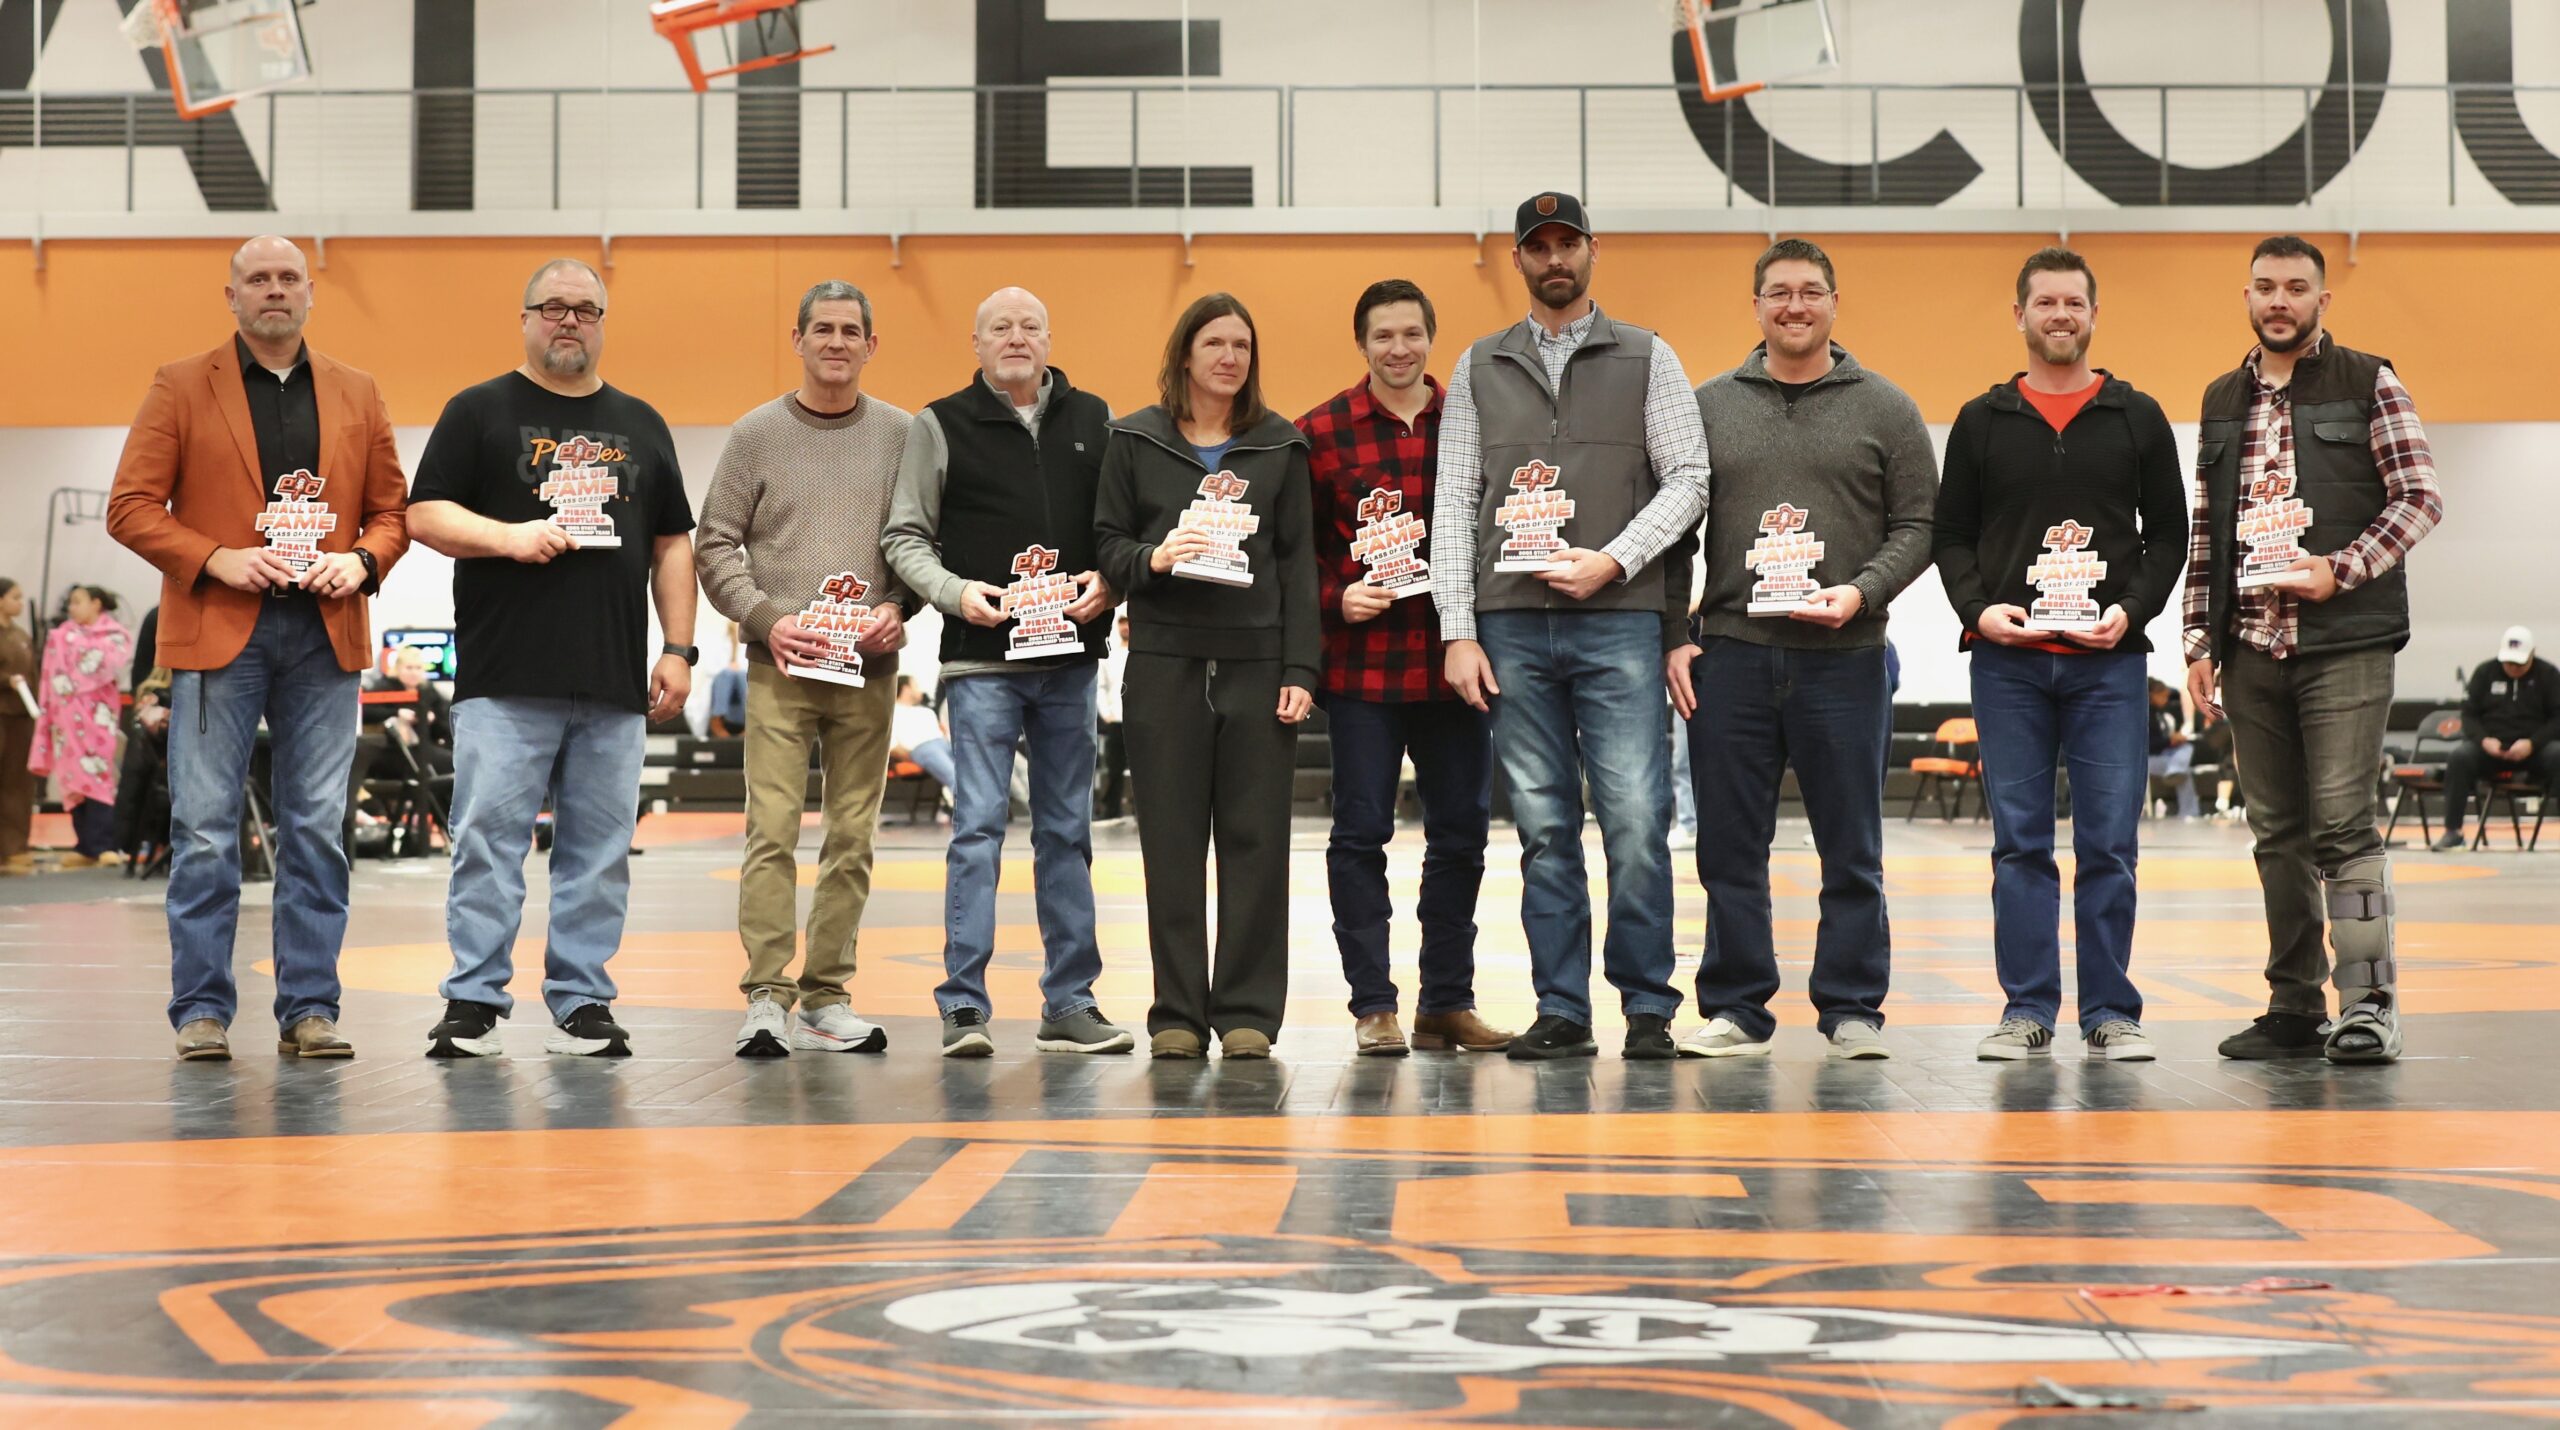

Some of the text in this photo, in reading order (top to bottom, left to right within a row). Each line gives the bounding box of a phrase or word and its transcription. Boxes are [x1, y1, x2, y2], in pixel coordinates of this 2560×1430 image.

[1671, 0, 2560, 208] CO
[553, 468, 607, 481] HALL OF
[544, 479, 617, 498] FAME
[1507, 492, 1562, 506] HALL OF
[270, 504, 326, 513] HALL OF
[1194, 503, 1249, 515] HALL OF
[1498, 501, 1571, 523] FAME
[2247, 501, 2298, 520] HALL OF
[258, 515, 335, 529] FAME
[1183, 512, 1256, 531] FAME
[1359, 515, 1411, 539] HALL OF
[2239, 510, 2308, 539] FAME
[277, 542, 311, 550] PIRATE
[1210, 541, 1233, 550] RATE
[1353, 522, 1424, 560] FAME
[1757, 535, 1812, 549] HALL OF
[2248, 536, 2269, 544] CLASS
[1204, 548, 1241, 559] ESTLING
[1748, 544, 1822, 566] FAME
[2259, 544, 2290, 553] PIRATE
[1365, 550, 1387, 563] CLASS
[2039, 553, 2095, 565] HALL OF
[1378, 558, 1410, 571] PIRATE
[1758, 564, 1781, 572] CLASS
[2029, 562, 2104, 582] FAME
[1011, 576, 1065, 594] HALL OF
[1003, 584, 1076, 612] FAME
[813, 604, 868, 617] HALL OF
[1014, 609, 1036, 617] CLASS
[800, 614, 876, 633] FAME
[1025, 617, 1059, 627] PIRATE
[816, 641, 849, 652] PIRATE
[829, 652, 855, 661] TLING
